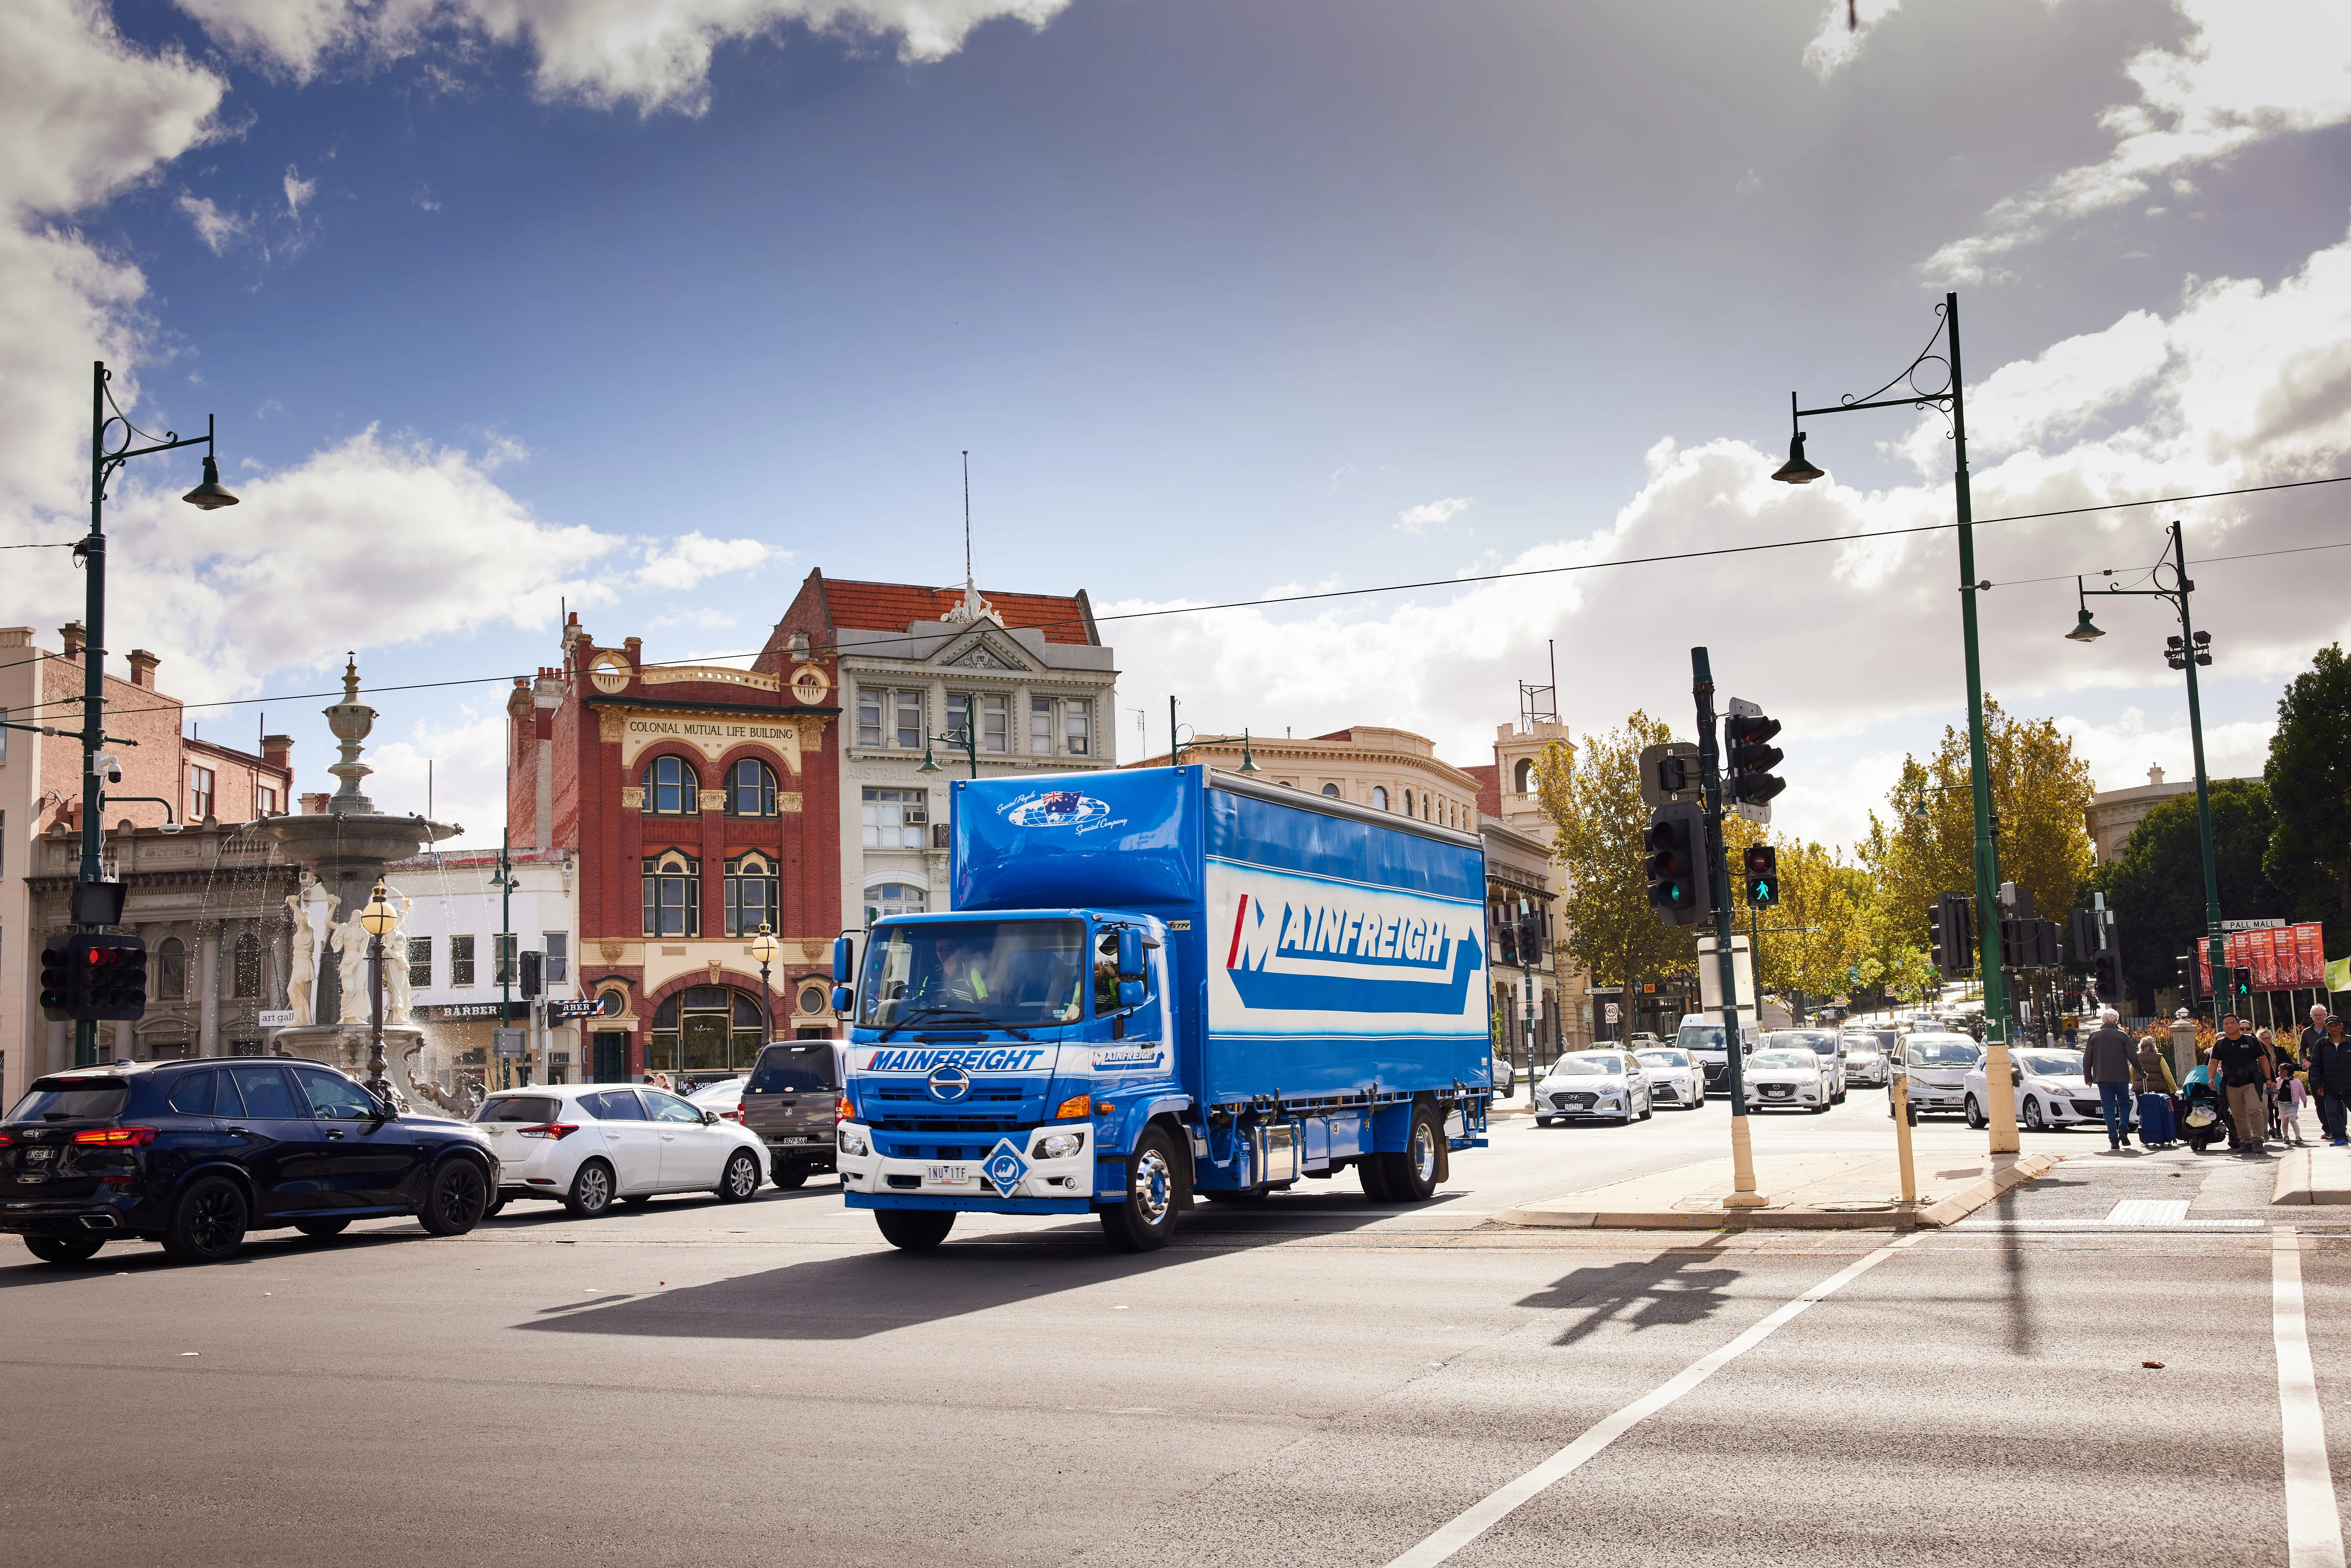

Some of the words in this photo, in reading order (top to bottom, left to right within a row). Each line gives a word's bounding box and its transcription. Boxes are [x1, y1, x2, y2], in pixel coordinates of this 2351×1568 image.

[630, 721, 680, 733] COLONIAL
[684, 724, 723, 735] MUTUAL
[726, 726, 746, 737] LIFE
[750, 728, 793, 739] BUILDING
[847, 765, 927, 781] AUSTRALIAN
[996, 797, 1018, 815] Special
[1017, 790, 1036, 804] People
[1075, 820, 1099, 836] Special
[1100, 818, 1128, 829] Company
[1227, 894, 1471, 972] MAINFREIGHT
[444, 1006, 497, 1016] BARBER
[867, 1050, 1045, 1070] MAINFREIGHT
[1092, 1051, 1162, 1066] MAINFREIGHT
[678, 1081, 688, 1091] the
[929, 1168, 943, 1178] 1NU
[951, 1168, 965, 1178] 1TF
